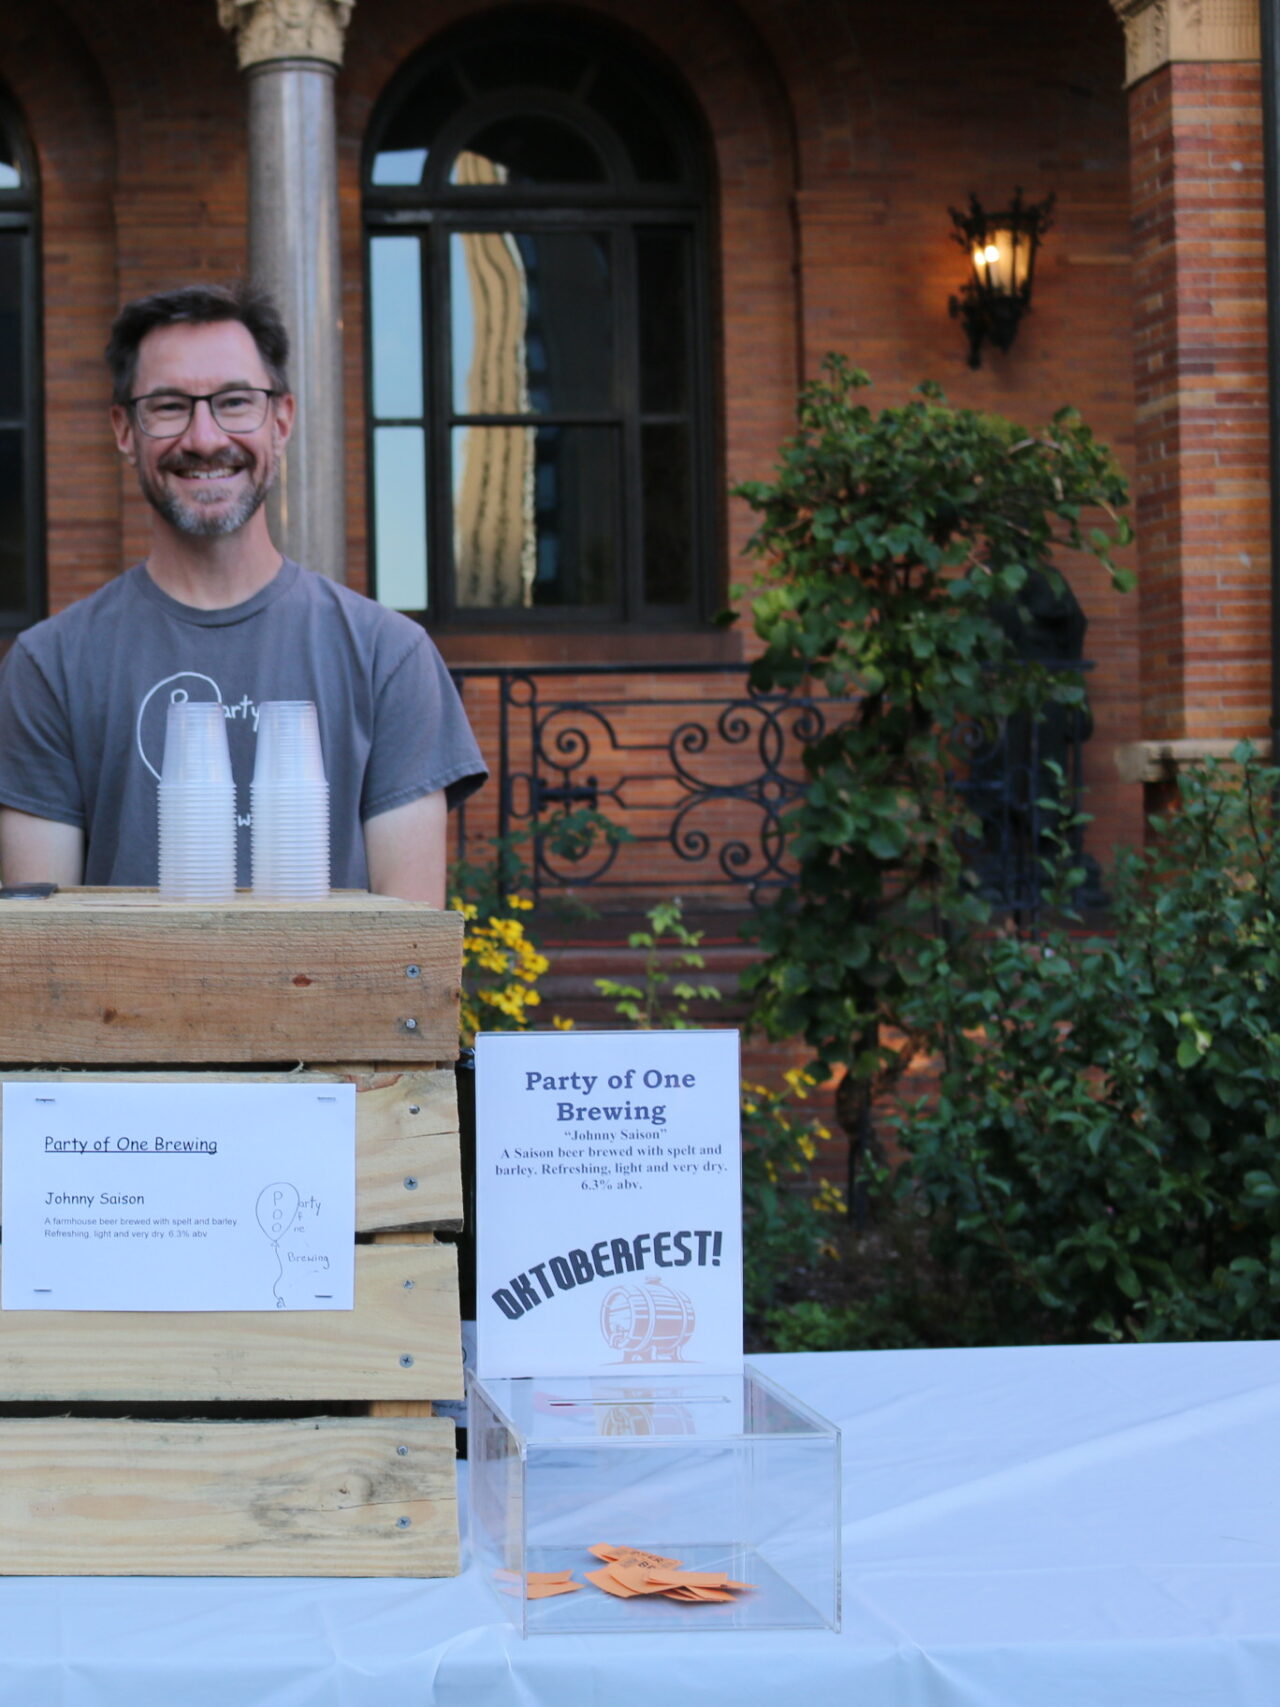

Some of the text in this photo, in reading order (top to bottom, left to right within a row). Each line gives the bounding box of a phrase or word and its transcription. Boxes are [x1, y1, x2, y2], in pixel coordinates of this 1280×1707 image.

[525, 1069, 696, 1096] Party of One
[556, 1101, 667, 1125] Brewing
[45, 1136, 218, 1156] Party of One Brewing
[501, 1143, 722, 1159] A Saison beer brewed with spelt and
[495, 1160, 728, 1178] barley. Refreshing, light and very dry.
[581, 1178, 642, 1191] 6.3% abv.
[45, 1191, 145, 1208] Johnny Saison
[44, 1216, 237, 1227] A farmhouse beer brewed with spelt and barley
[93, 1230, 112, 1239] light
[114, 1230, 129, 1238] and
[131, 1231, 149, 1239] very
[287, 1251, 330, 1270] Brewing
[491, 1229, 723, 1321] OKTOBERFEST!
